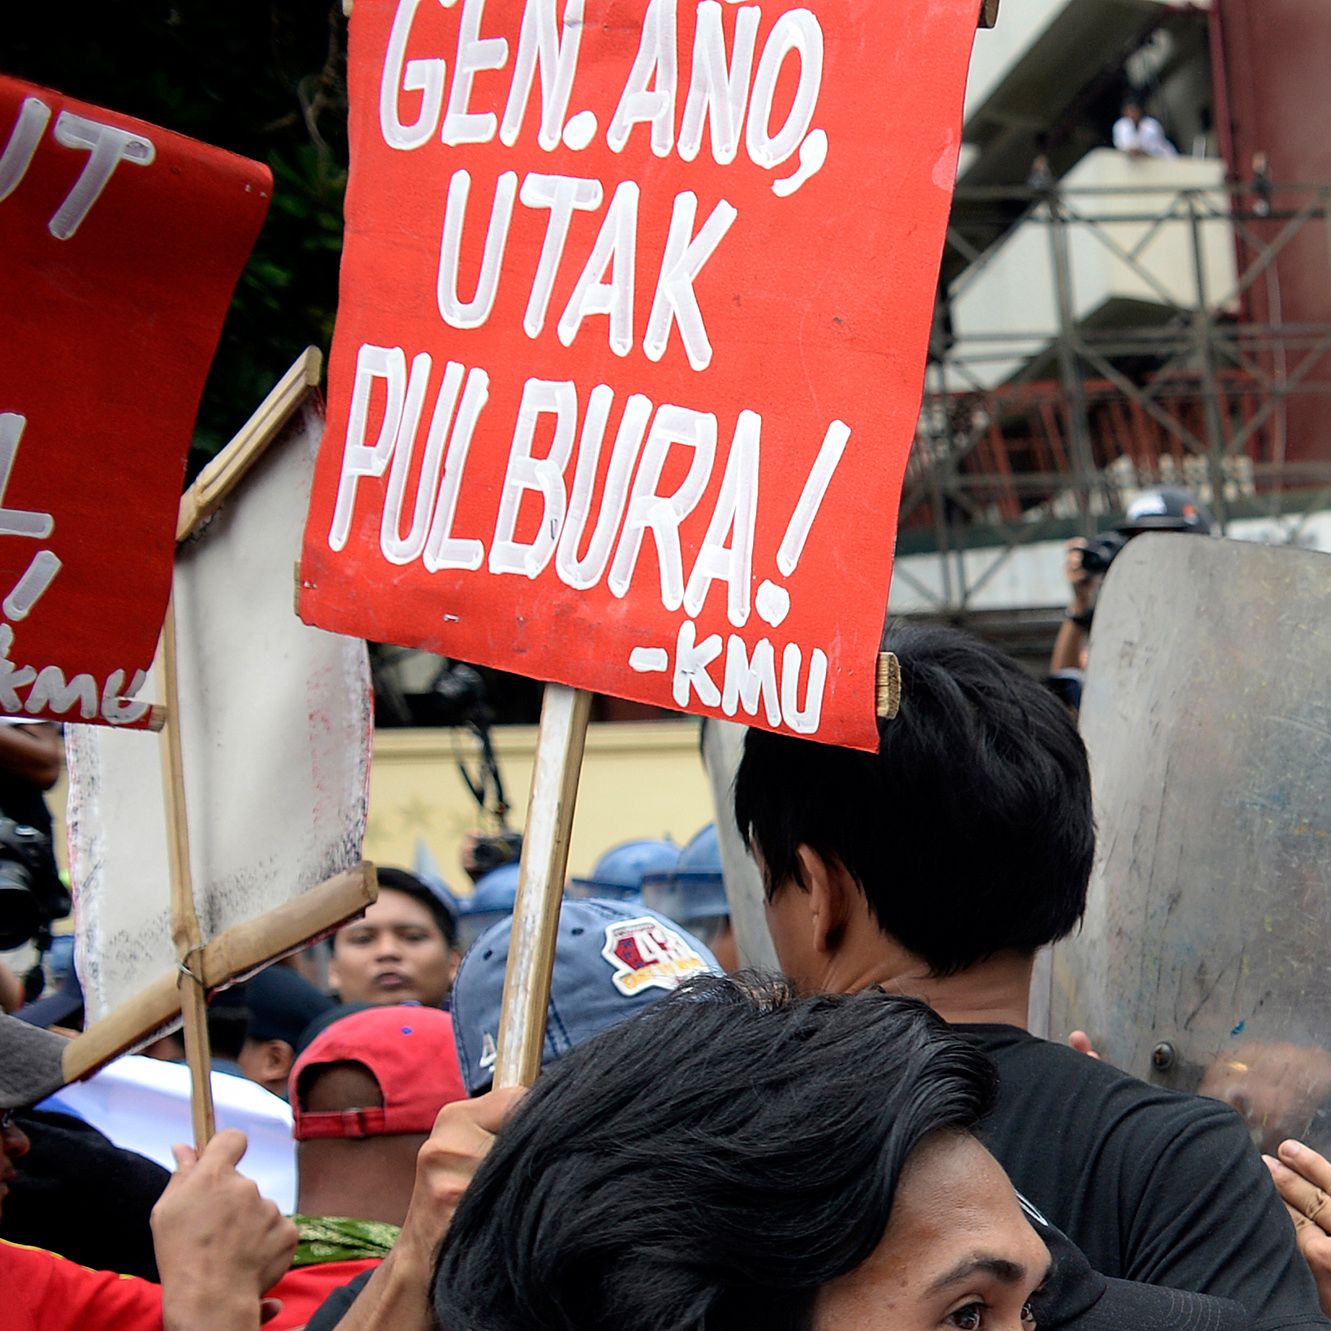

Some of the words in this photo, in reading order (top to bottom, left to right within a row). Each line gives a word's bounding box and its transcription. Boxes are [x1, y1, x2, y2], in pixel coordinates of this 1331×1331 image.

[437, 169, 737, 371] UTAK
[328, 343, 851, 628] PULBURA!
[629, 620, 828, 733] -KMU
